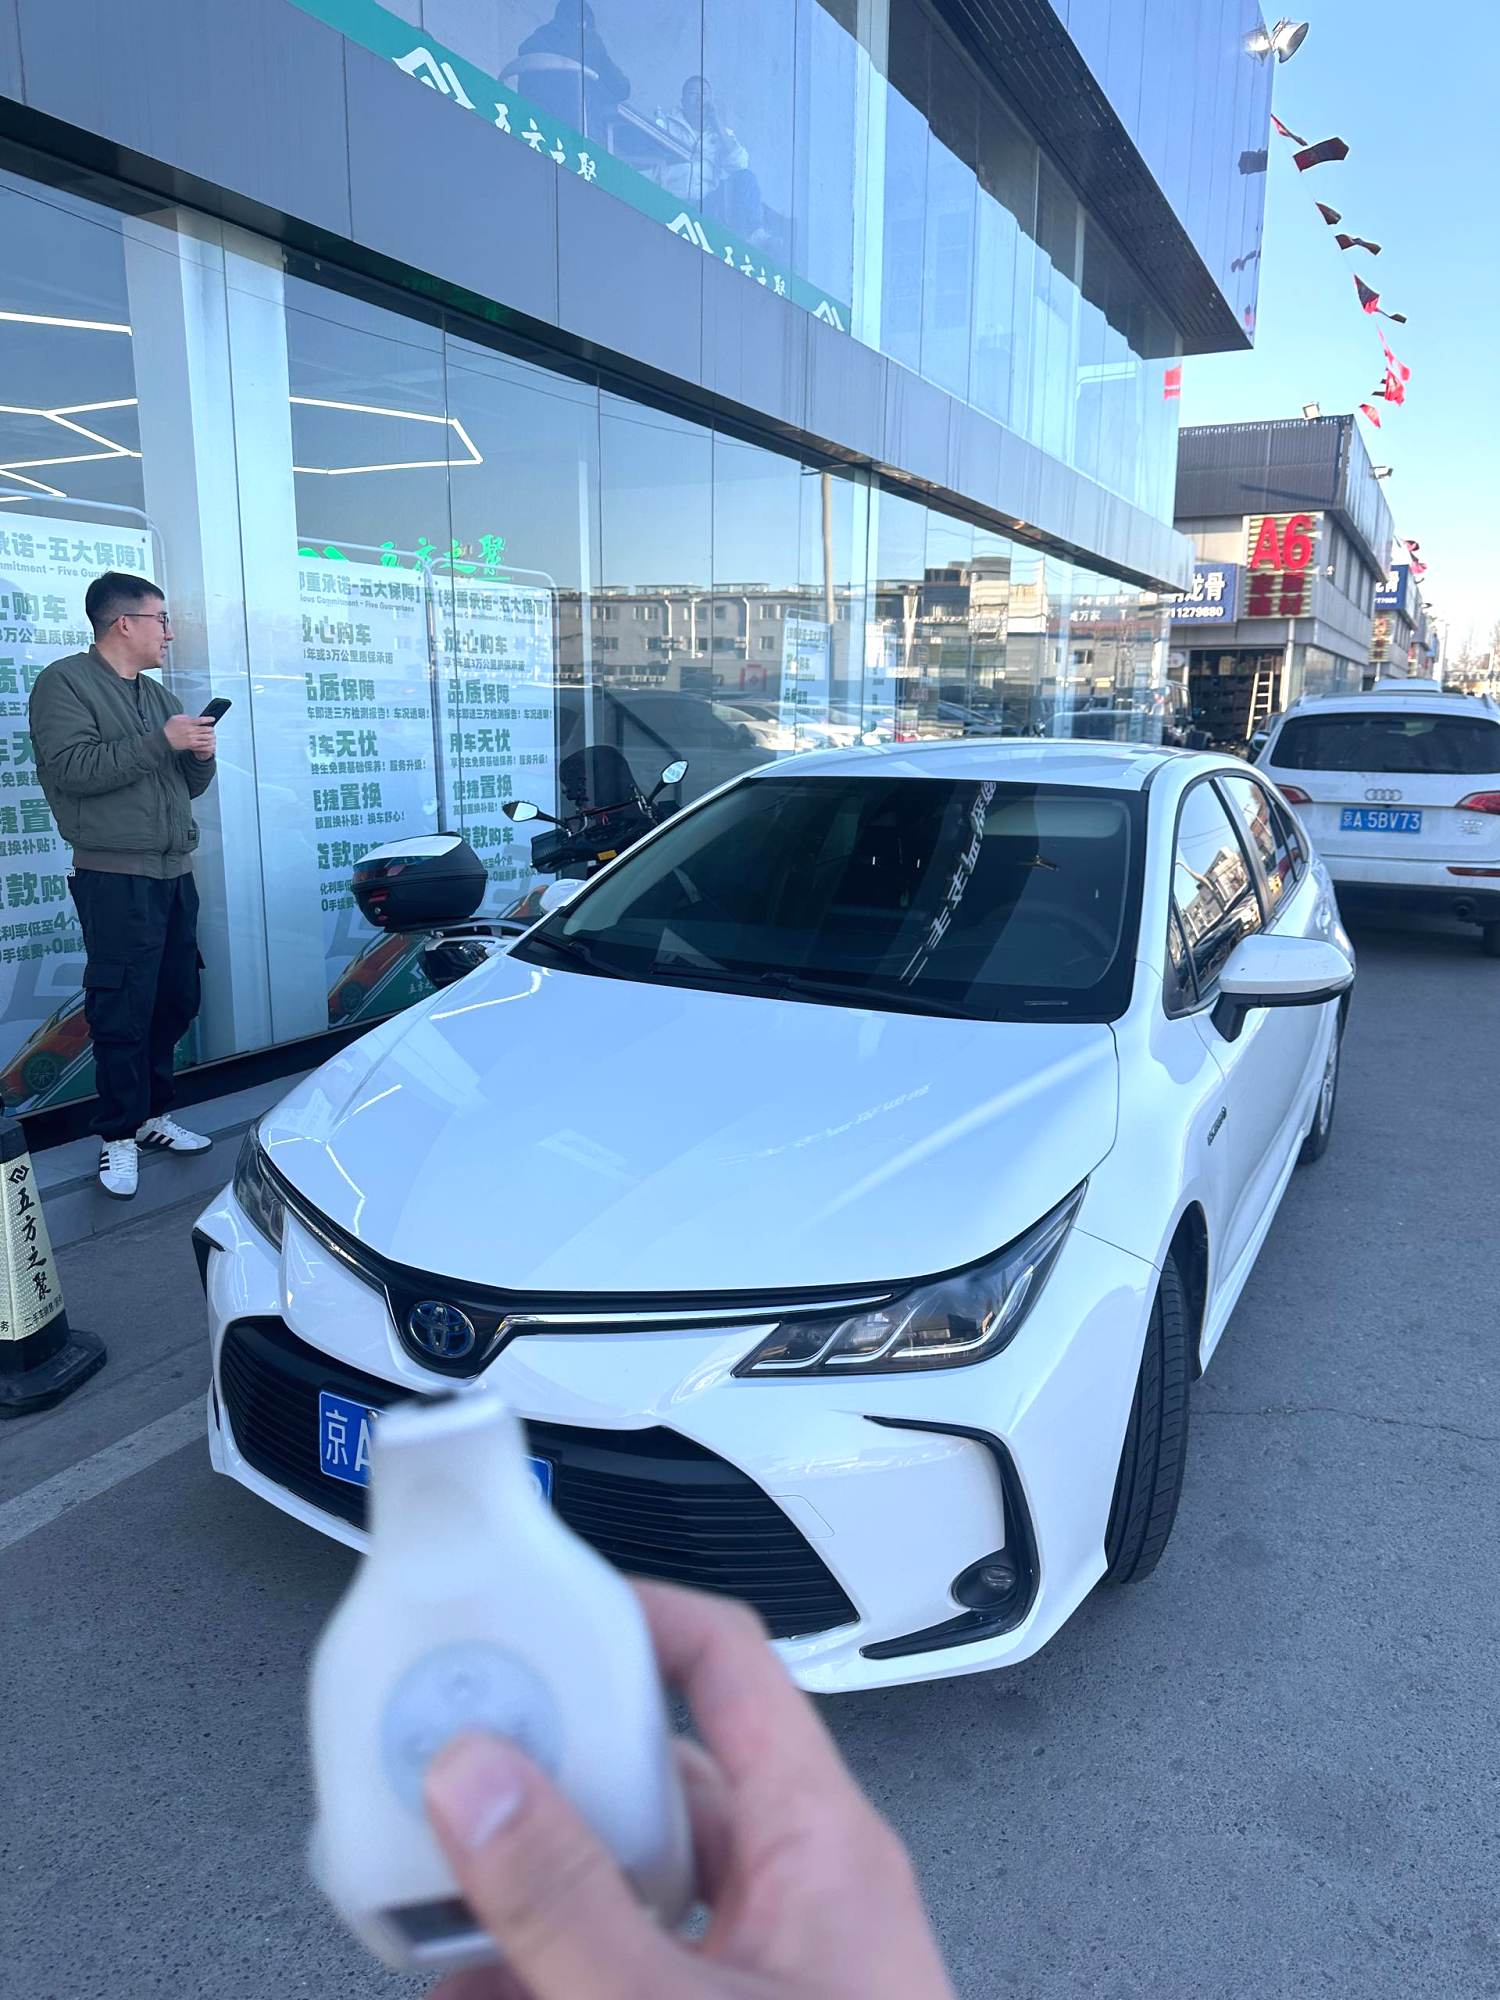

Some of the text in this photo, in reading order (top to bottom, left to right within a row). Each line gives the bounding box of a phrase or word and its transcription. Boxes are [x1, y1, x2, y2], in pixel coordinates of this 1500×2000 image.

[1251, 514, 1313, 571] A6
[57, 566, 79, 577] Five
[443, 627, 508, 656] 放心购车
[447, 679, 510, 705] 品质保障
[450, 728, 512, 754] 用车无忧
[453, 774, 513, 801] 便捷置换
[0, 871, 67, 910] 款购
[0, 911, 80, 943] 利率低至4个
[0, 937, 85, 964] 手续费+0服
[18, 1187, 51, 1301] 五方之聚
